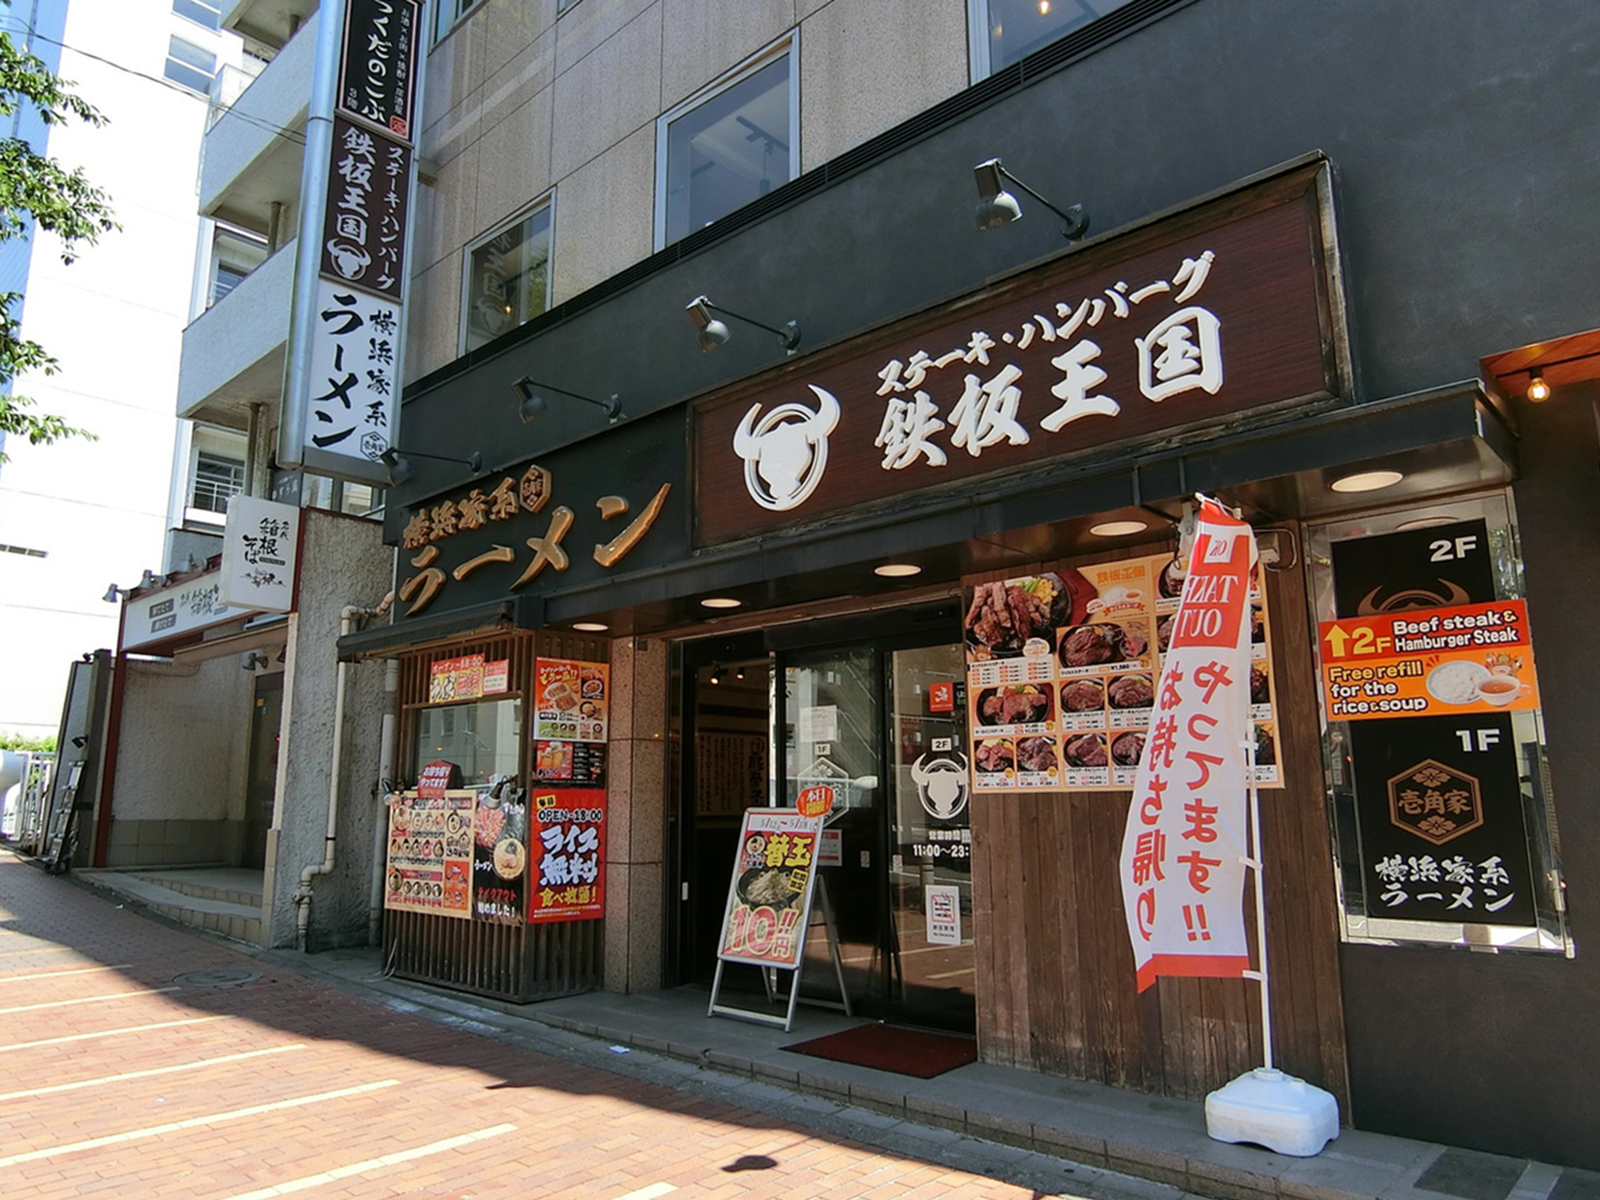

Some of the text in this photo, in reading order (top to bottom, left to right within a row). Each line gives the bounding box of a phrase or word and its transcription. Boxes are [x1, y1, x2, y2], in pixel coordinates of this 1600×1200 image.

[336, 126, 376, 245] 鉄板王国
[311, 293, 364, 448] ラーメン
[363, 310, 397, 428] 横浜家系
[874, 305, 1223, 471] 鉄板王国
[258, 517, 280, 557] 箱根
[399, 482, 673, 617] ラーメン
[1429, 535, 1477, 562] 2F
[1392, 610, 1518, 636] Beef steak &
[1351, 626, 1392, 655] 2F
[1395, 626, 1519, 653] Hamburger Steak
[1328, 660, 1424, 684] Free refill
[1330, 679, 1398, 699] for the
[934, 740, 950, 750] 2F
[1455, 728, 1501, 753] 1F
[1397, 788, 1474, 816] 壱角家
[539, 825, 600, 855] ライス
[763, 833, 814, 868] 替玉
[539, 853, 599, 886] 無料
[1373, 853, 1510, 885] 横浜家系
[478, 886, 517, 901] テイクアウト
[1379, 881, 1516, 912] ラーメン
